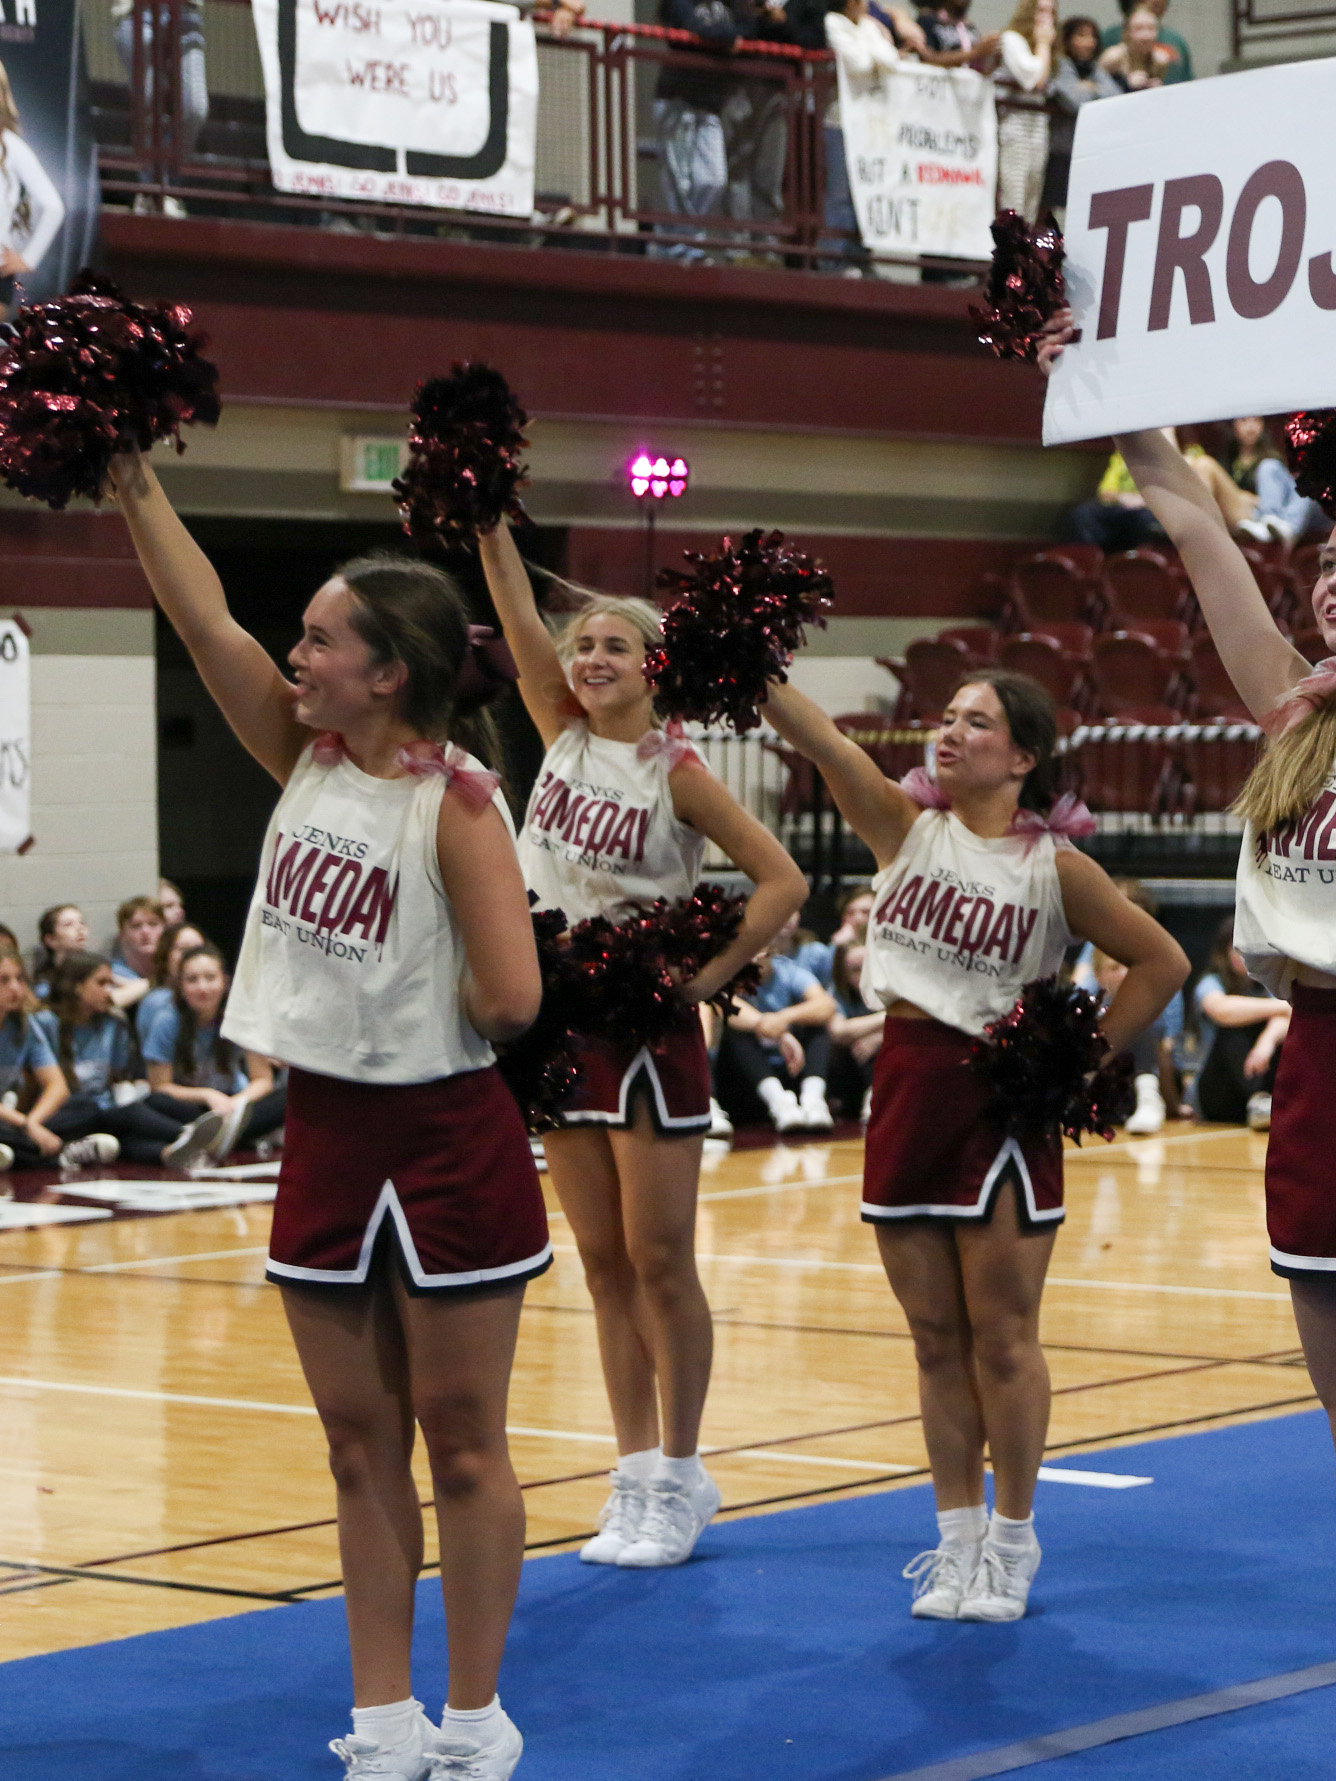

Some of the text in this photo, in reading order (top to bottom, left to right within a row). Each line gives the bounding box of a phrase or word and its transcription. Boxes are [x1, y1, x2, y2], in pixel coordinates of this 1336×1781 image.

[313, 0, 453, 50] WISH YOU
[346, 58, 458, 106] WERE US
[292, 825, 369, 859] JENKS
[930, 867, 996, 897] JENKS
[261, 910, 368, 963] EAT UNION
[881, 927, 1001, 977] BEAT UNION
